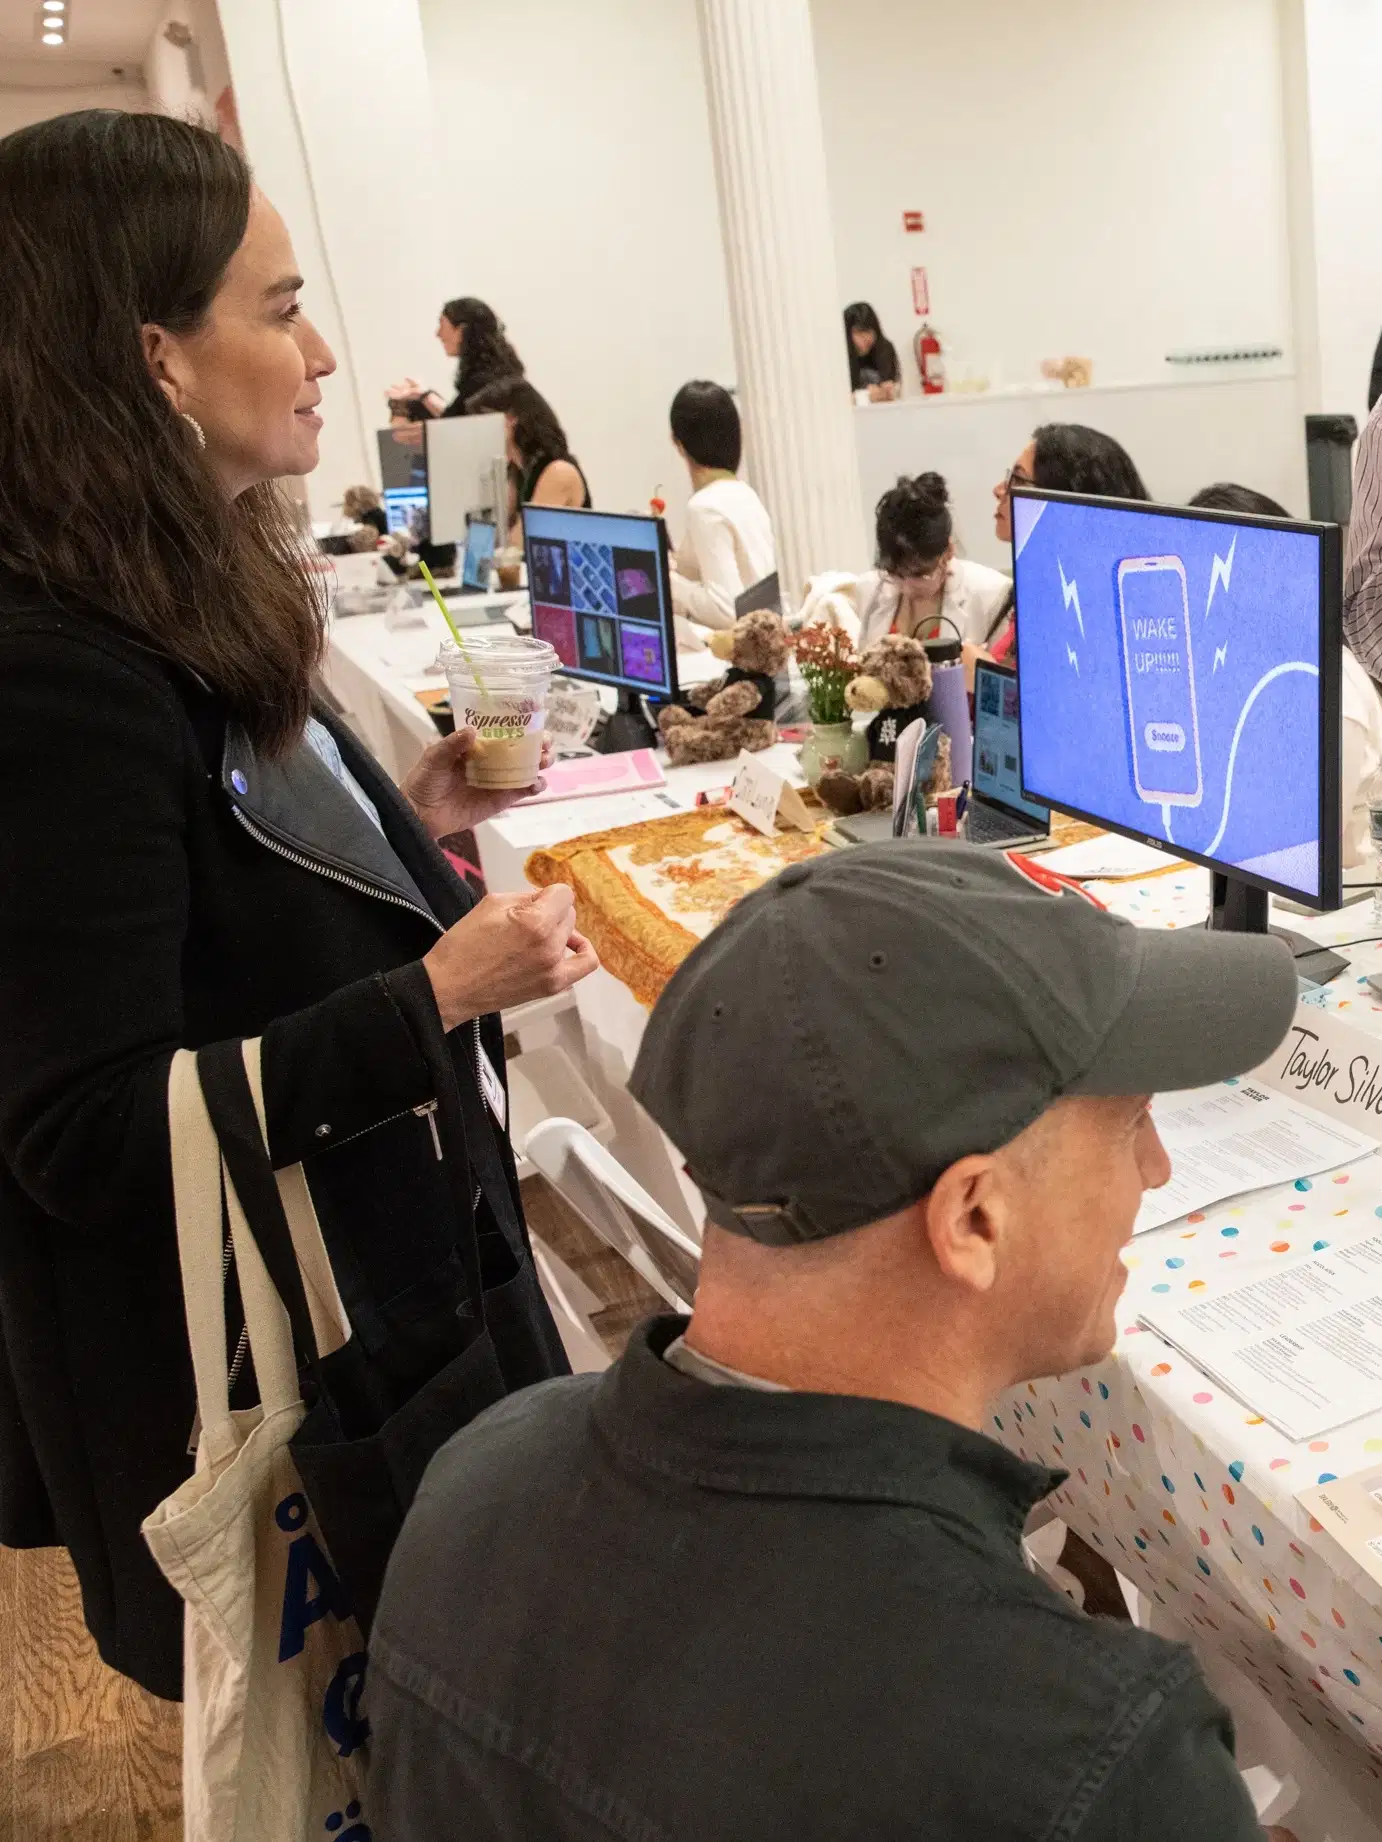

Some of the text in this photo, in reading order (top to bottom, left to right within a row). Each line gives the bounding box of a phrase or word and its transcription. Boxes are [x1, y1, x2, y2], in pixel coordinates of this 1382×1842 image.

[1132, 616, 1178, 641] WAKE
[464, 707, 532, 731] Espresso
[482, 727, 525, 739] GUYS
[1151, 729, 1180, 744] Snooze
[1280, 1026, 1339, 1090] Taylor
